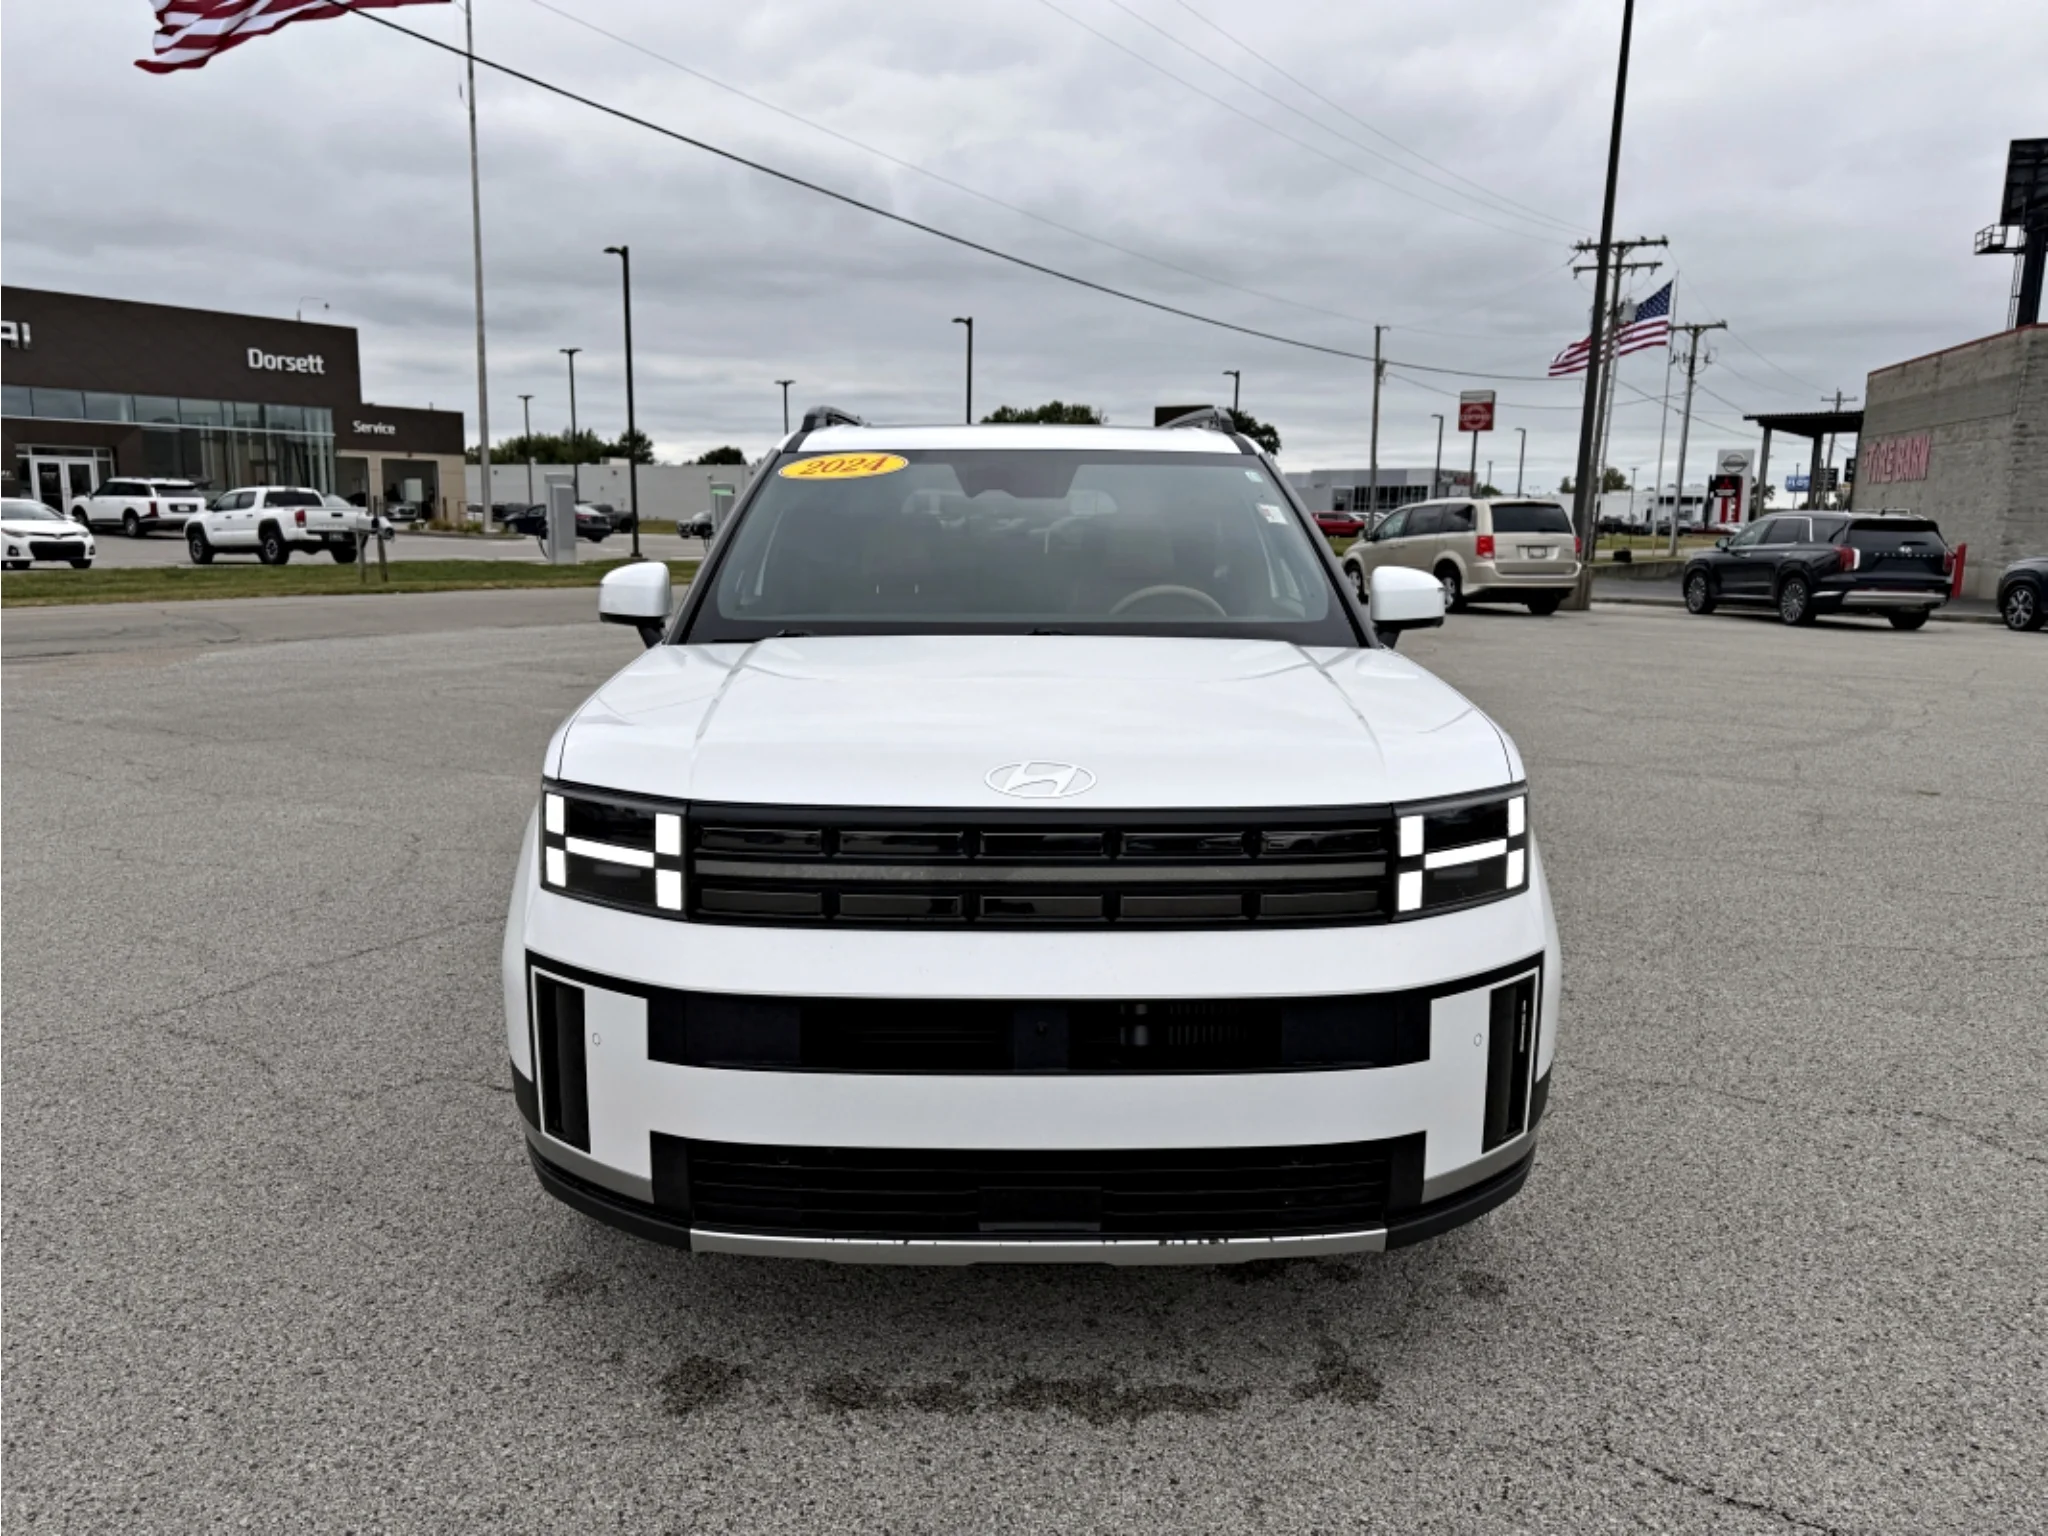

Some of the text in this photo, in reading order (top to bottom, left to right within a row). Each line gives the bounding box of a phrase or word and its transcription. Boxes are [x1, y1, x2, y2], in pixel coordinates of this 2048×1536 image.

[247, 348, 326, 374] Dorsett
[352, 420, 396, 435] Service
[799, 455, 889, 475] 2024
